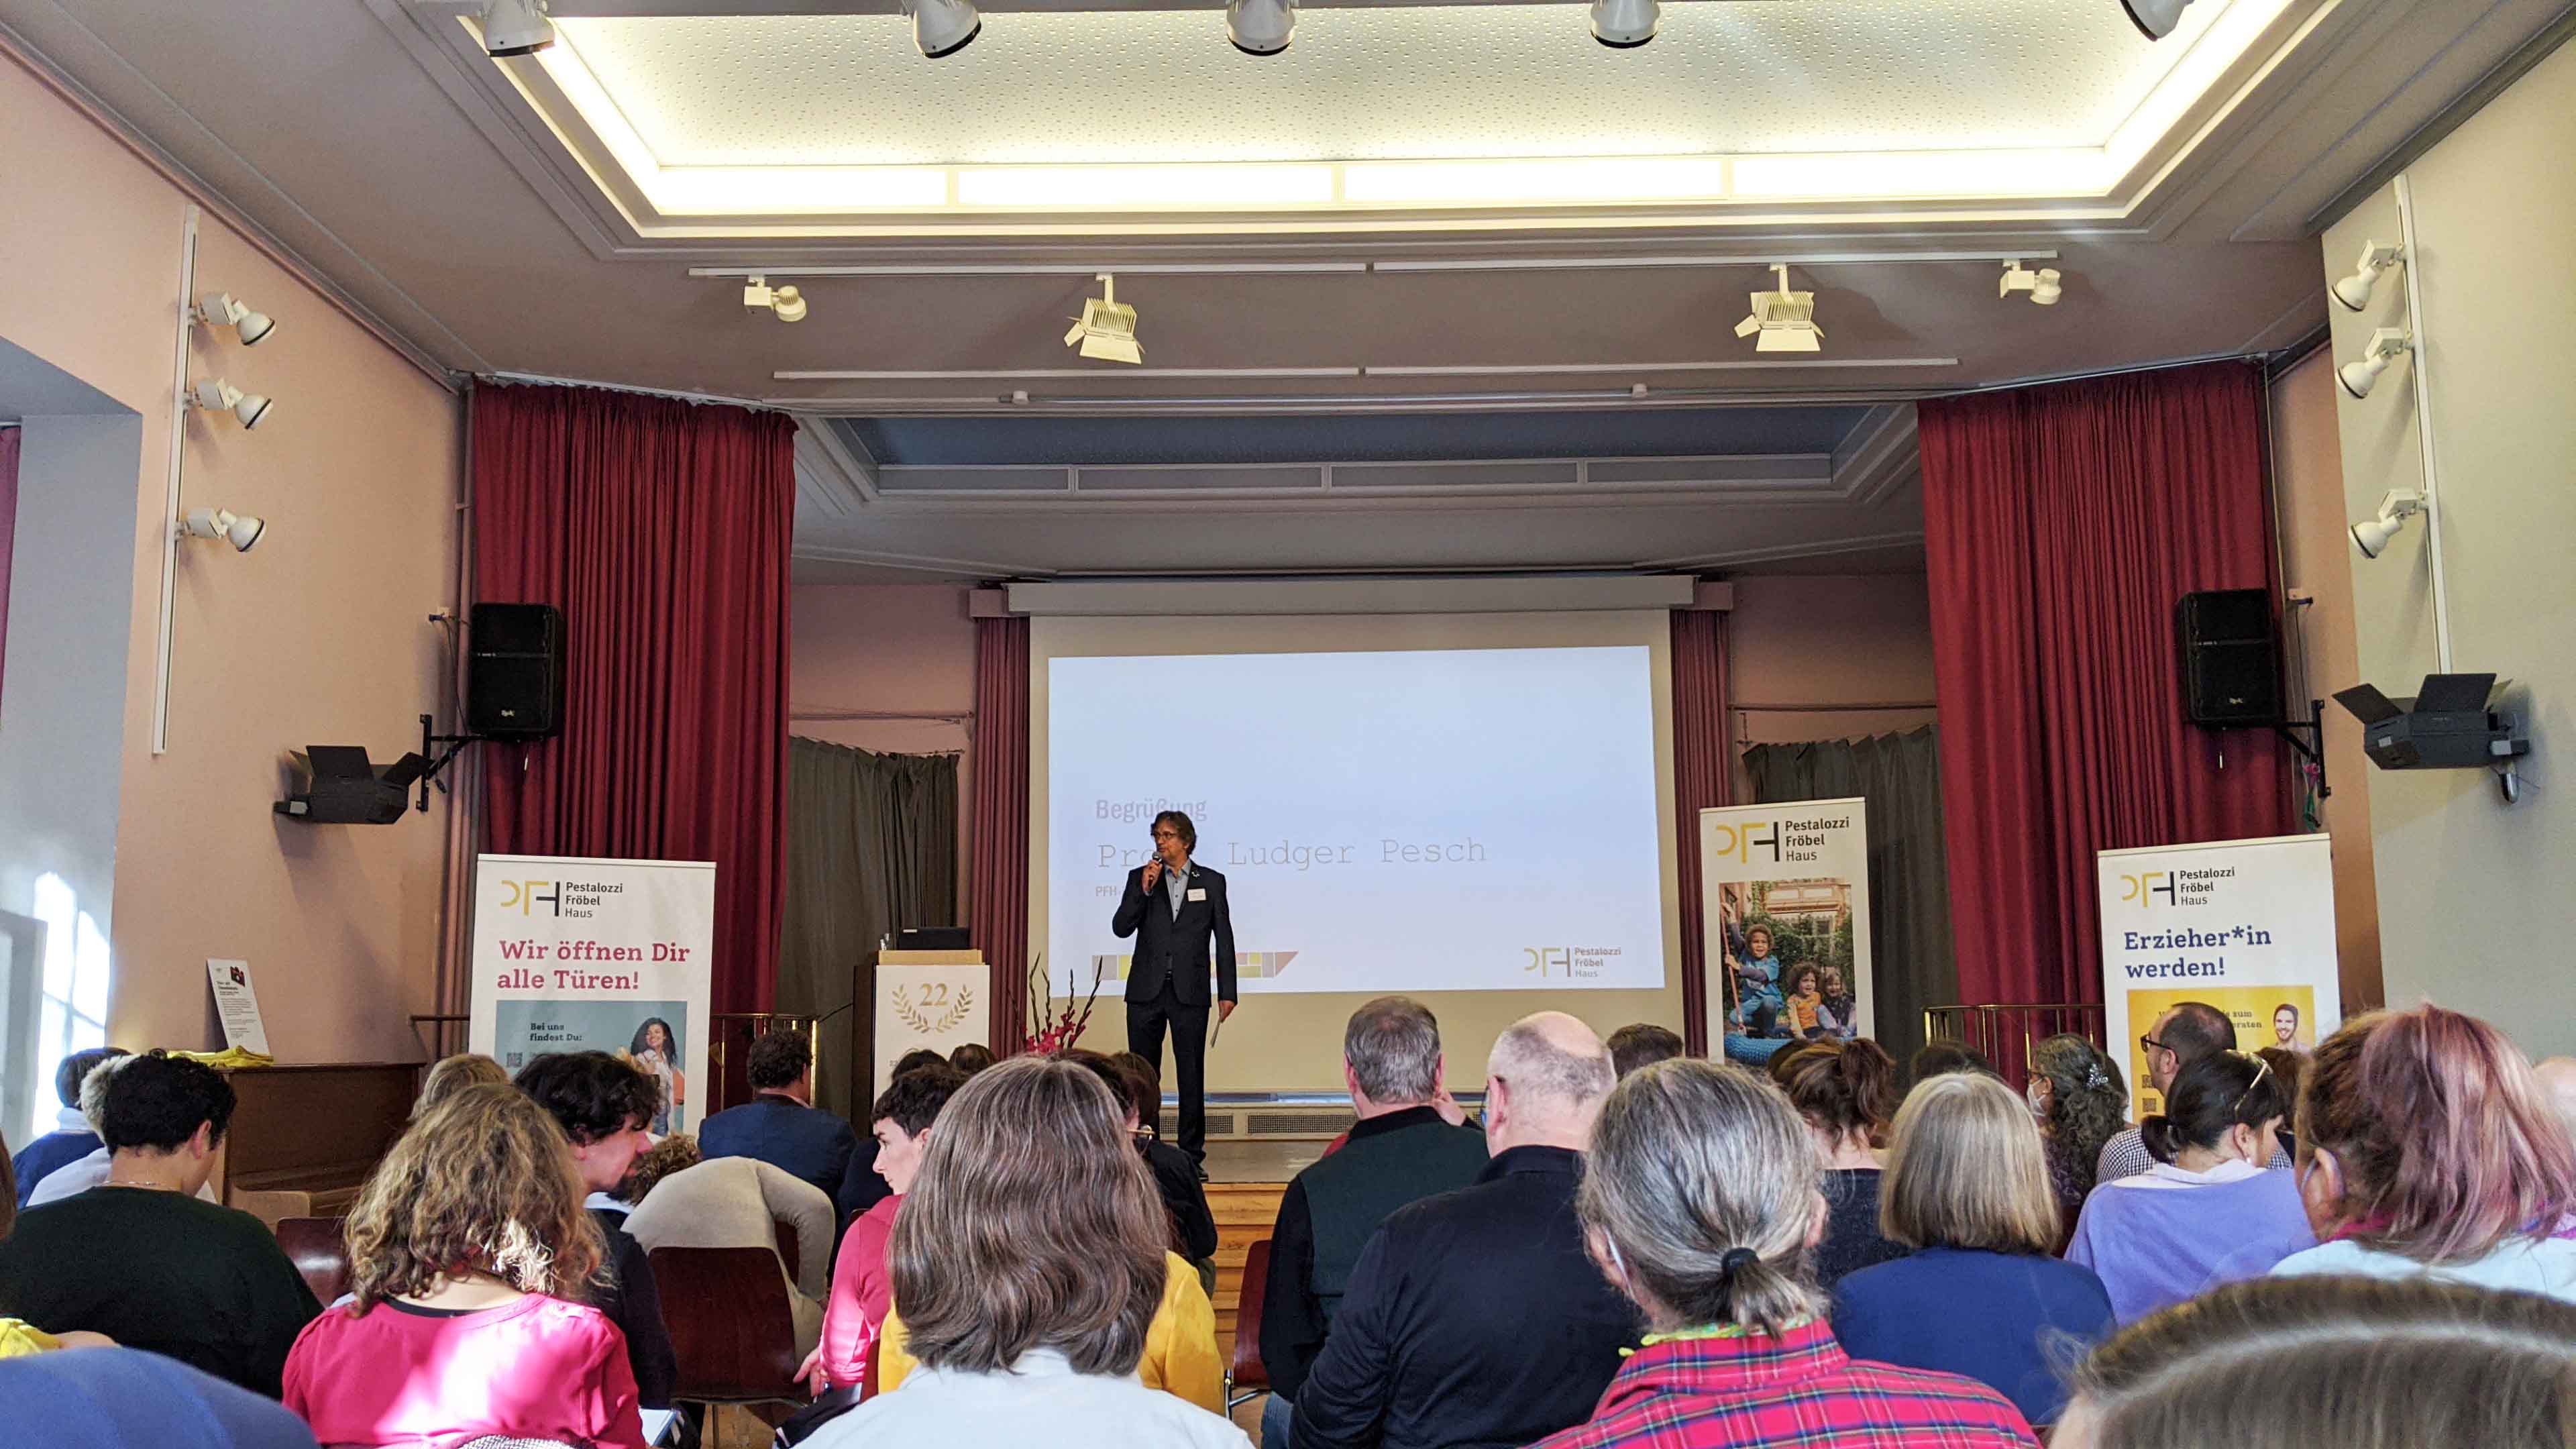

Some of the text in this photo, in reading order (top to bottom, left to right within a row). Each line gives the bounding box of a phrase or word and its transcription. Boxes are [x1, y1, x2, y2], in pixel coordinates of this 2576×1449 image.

[1096, 798, 1208, 823] Begrüßung
[1785, 816, 1849, 831] Pestalozzi
[1786, 834, 1825, 847] Fröbel
[1227, 839, 1355, 871] Ludger
[1380, 837, 1487, 863] Pesch
[1786, 851, 1817, 861] Haus
[2180, 867, 2235, 879] Pestalozzi
[566, 881, 623, 893] Pestalozzi
[2180, 881, 2214, 893] Fröbel
[566, 895, 600, 906] Fröbel
[2181, 896, 2208, 906] Haus
[565, 908, 592, 918] Haus
[500, 939, 690, 961] Wir öffnen Dir
[1574, 947, 1621, 956] Pestalozzi
[1575, 958, 1603, 967] Fröbel
[2125, 957, 2224, 978] werden!
[497, 969, 639, 989] alle Türen!
[919, 983, 949, 1006] 22
[531, 1022, 545, 1031] Bei
[530, 1033, 564, 1041] findest
